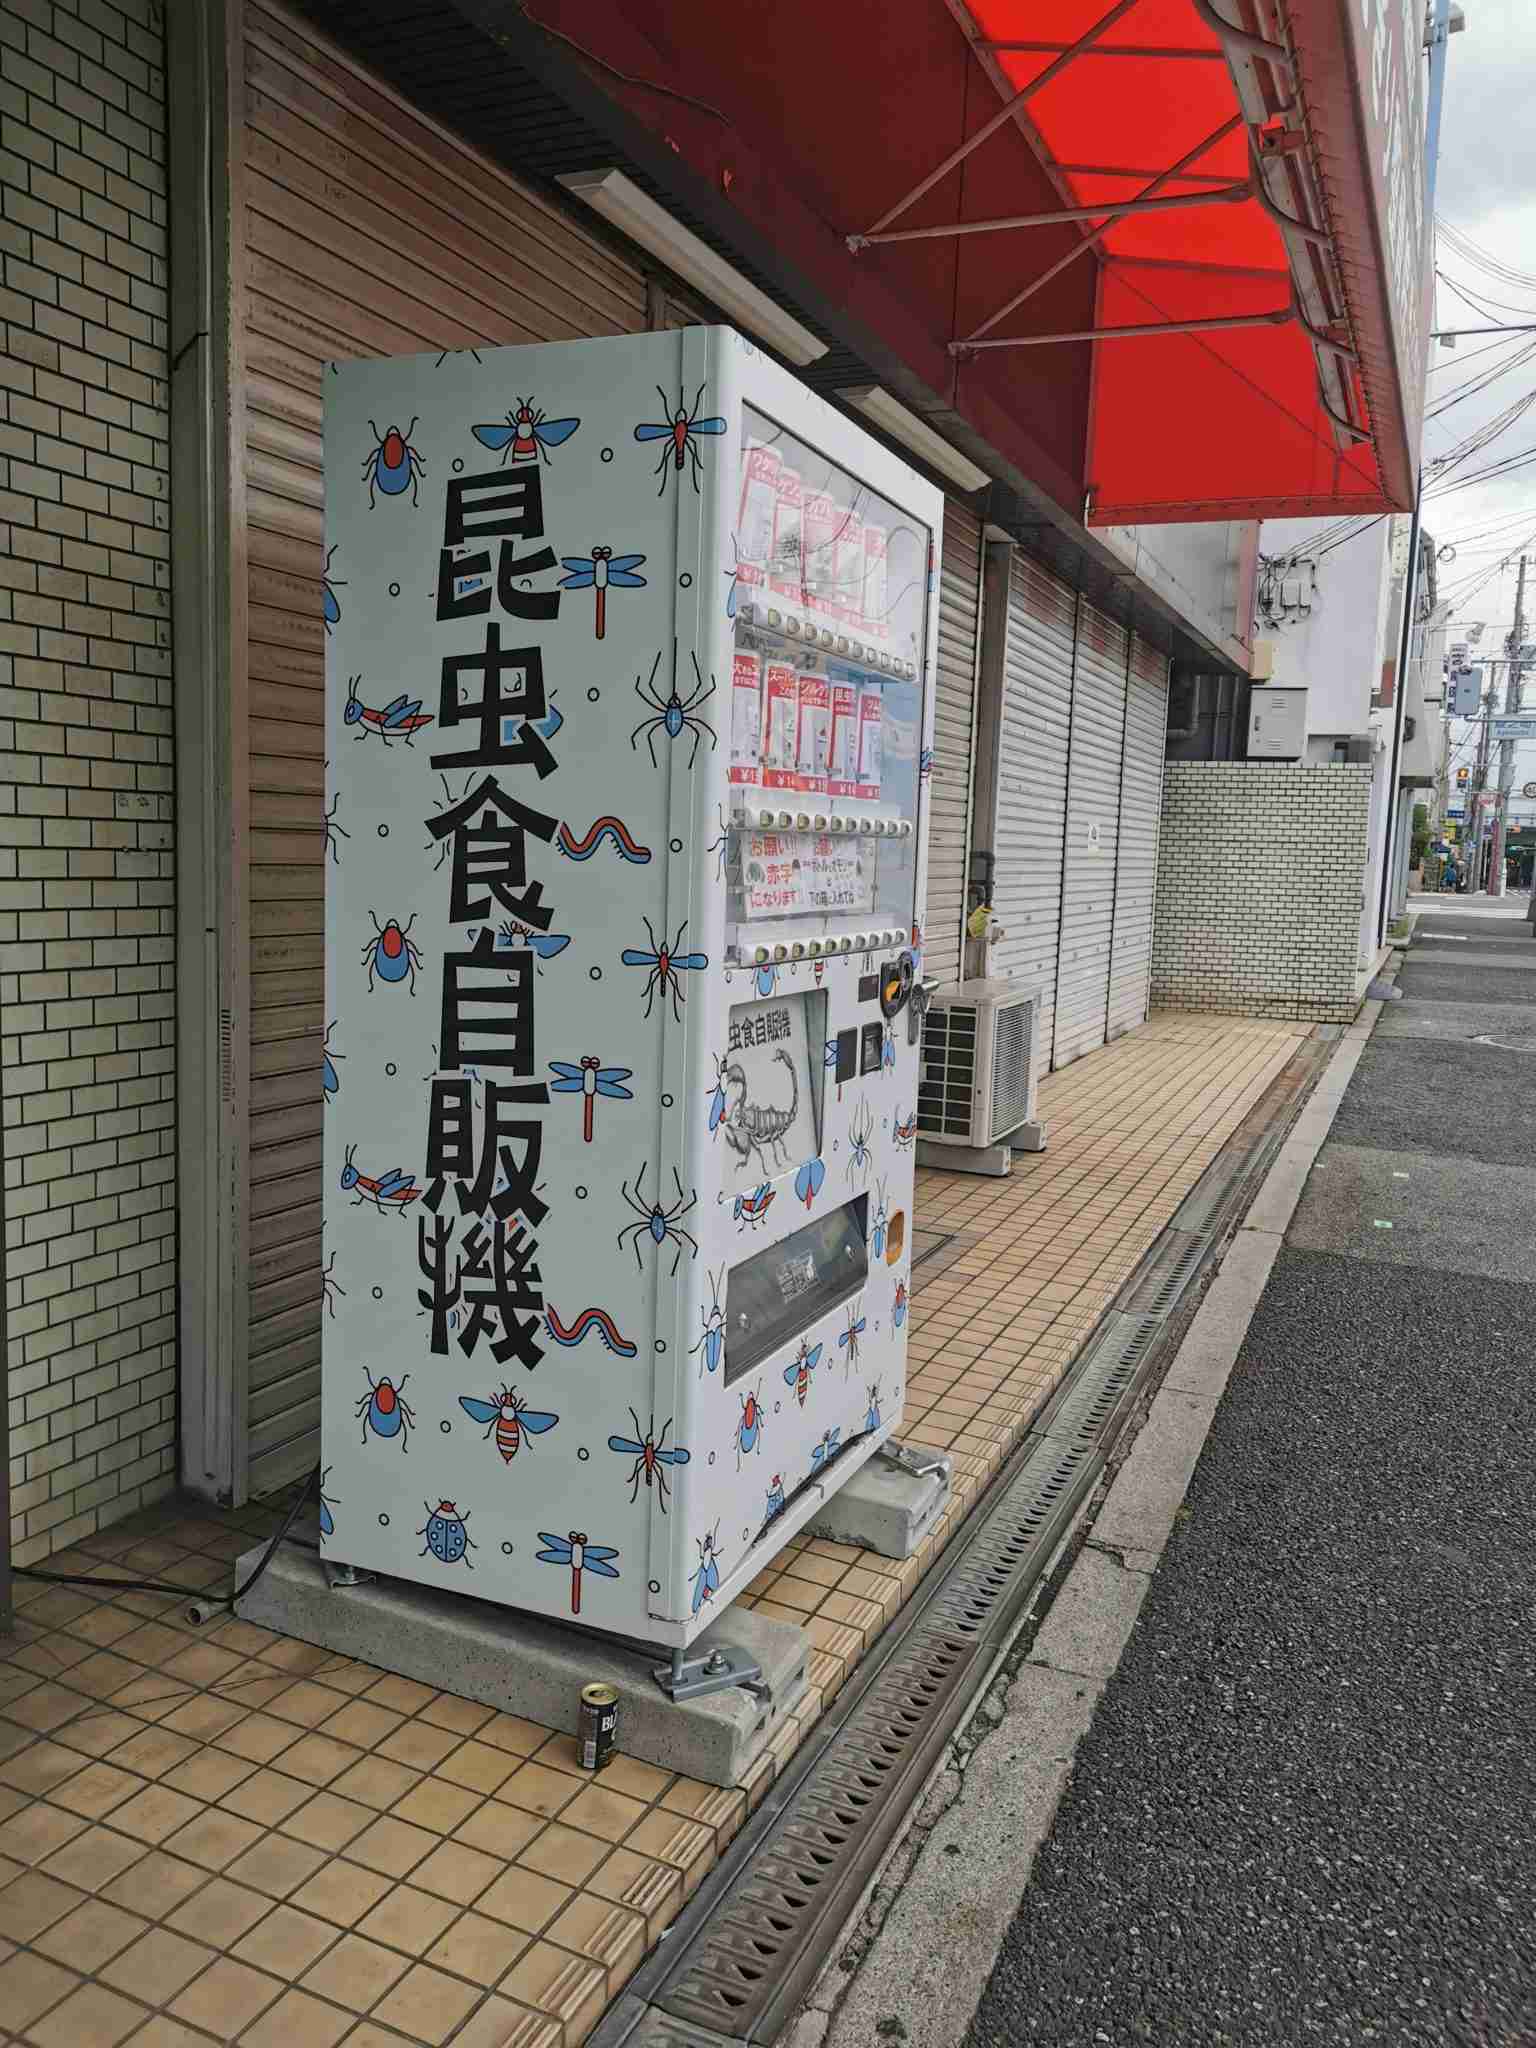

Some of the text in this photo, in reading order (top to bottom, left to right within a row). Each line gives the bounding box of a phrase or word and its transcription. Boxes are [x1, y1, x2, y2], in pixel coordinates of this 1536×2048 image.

[419, 464, 562, 1371] 昆虫食自販機
